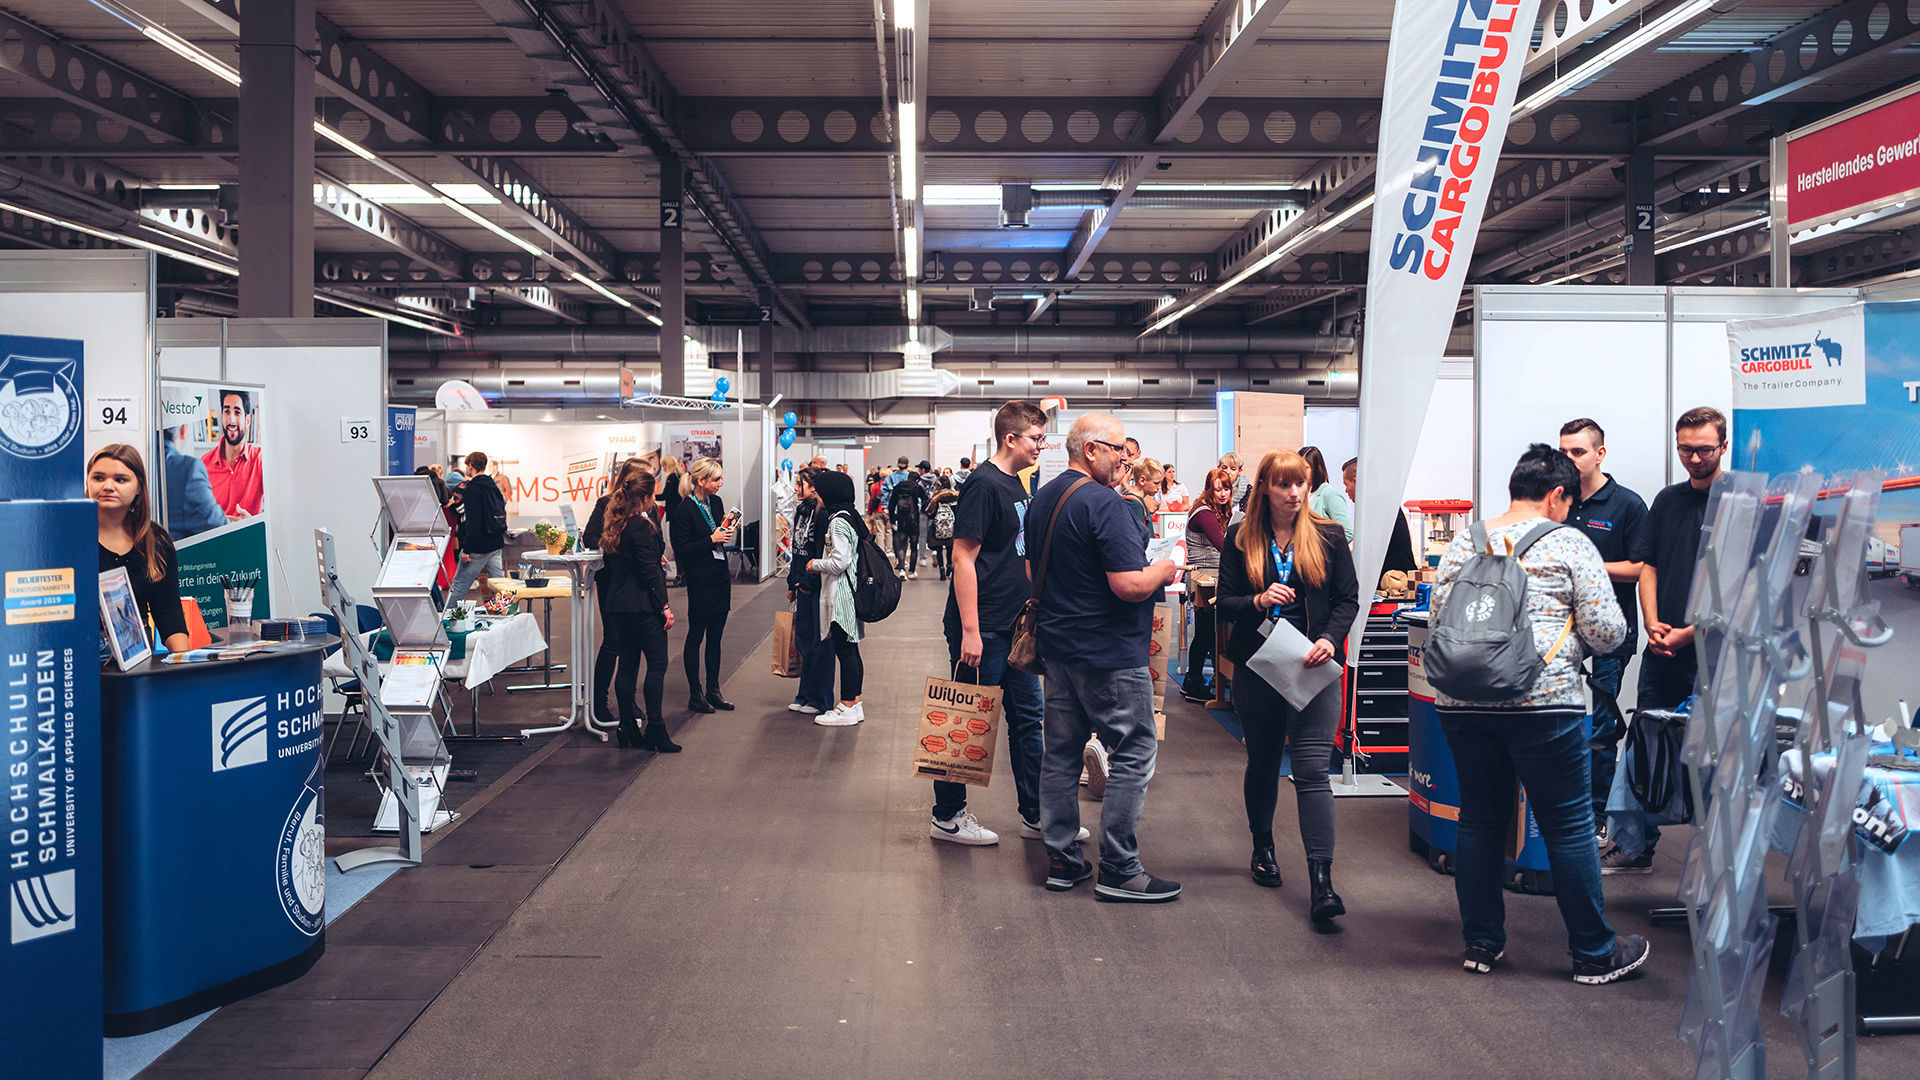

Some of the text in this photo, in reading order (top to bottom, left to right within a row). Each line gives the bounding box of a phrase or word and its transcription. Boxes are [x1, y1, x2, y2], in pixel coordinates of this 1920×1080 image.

[1423, 0, 1522, 281] CARGOBUL
[1797, 151, 1875, 193] Herstellendes
[664, 208, 678, 227] 2
[1637, 212, 1651, 230] 2
[762, 310, 770, 321] 2
[1741, 342, 1812, 362] SCHMITZ
[1741, 358, 1812, 374] CARGOBULL
[1743, 382, 1759, 390] The
[102, 407, 127, 425] 94
[161, 400, 197, 414] Nestor
[350, 426, 368, 439] 93
[608, 435, 637, 444] STRABAG
[567, 458, 598, 472] STRABAG
[567, 475, 618, 503] WO
[1167, 520, 1186, 531] Osp
[196, 574, 204, 586] in
[230, 568, 262, 583] Zukunft
[20, 596, 62, 606] Award 2019
[8, 652, 29, 871] HOCHSCHULE
[36, 649, 57, 864] SCHMALKALDEN
[63, 647, 76, 858] UNIVERSITY OF APPLIED SCIENCES
[281, 847, 291, 886] Familie
[284, 887, 295, 907] und
